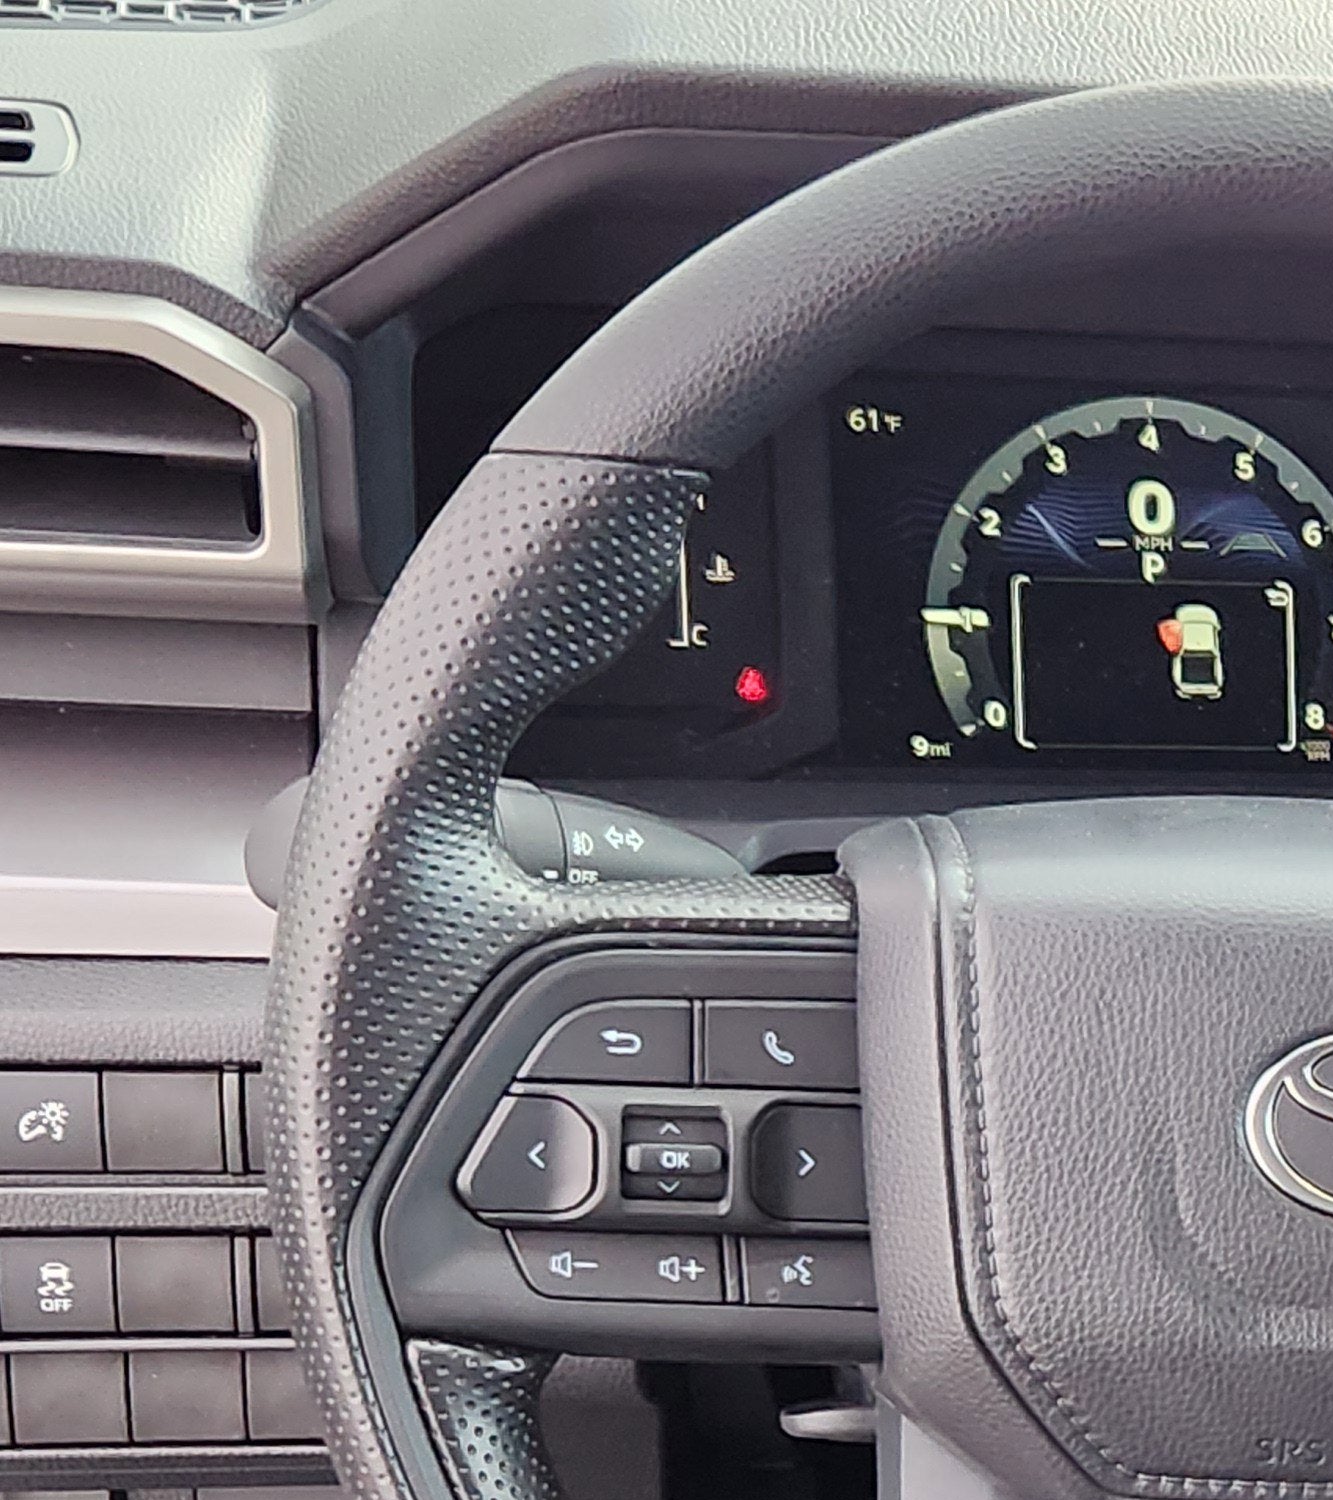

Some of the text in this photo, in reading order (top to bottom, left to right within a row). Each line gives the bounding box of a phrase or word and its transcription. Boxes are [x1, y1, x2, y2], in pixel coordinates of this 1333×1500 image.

[1138, 426, 1160, 452] 4
[1045, 449, 1067, 474] 3
[1235, 453, 1255, 479] 5
[1128, 479, 1175, 535] 0
[980, 510, 1002, 536] 2
[1301, 520, 1323, 546] 6
[1132, 535, 1174, 551] MPH
[1141, 551, 1166, 584] P
[692, 624, 709, 647] C
[983, 700, 1007, 729] 0
[1304, 702, 1325, 731] 8
[661, 1151, 690, 1169] OK
[40, 1298, 73, 1313] OFF
[1255, 1437, 1328, 1467] SRS
